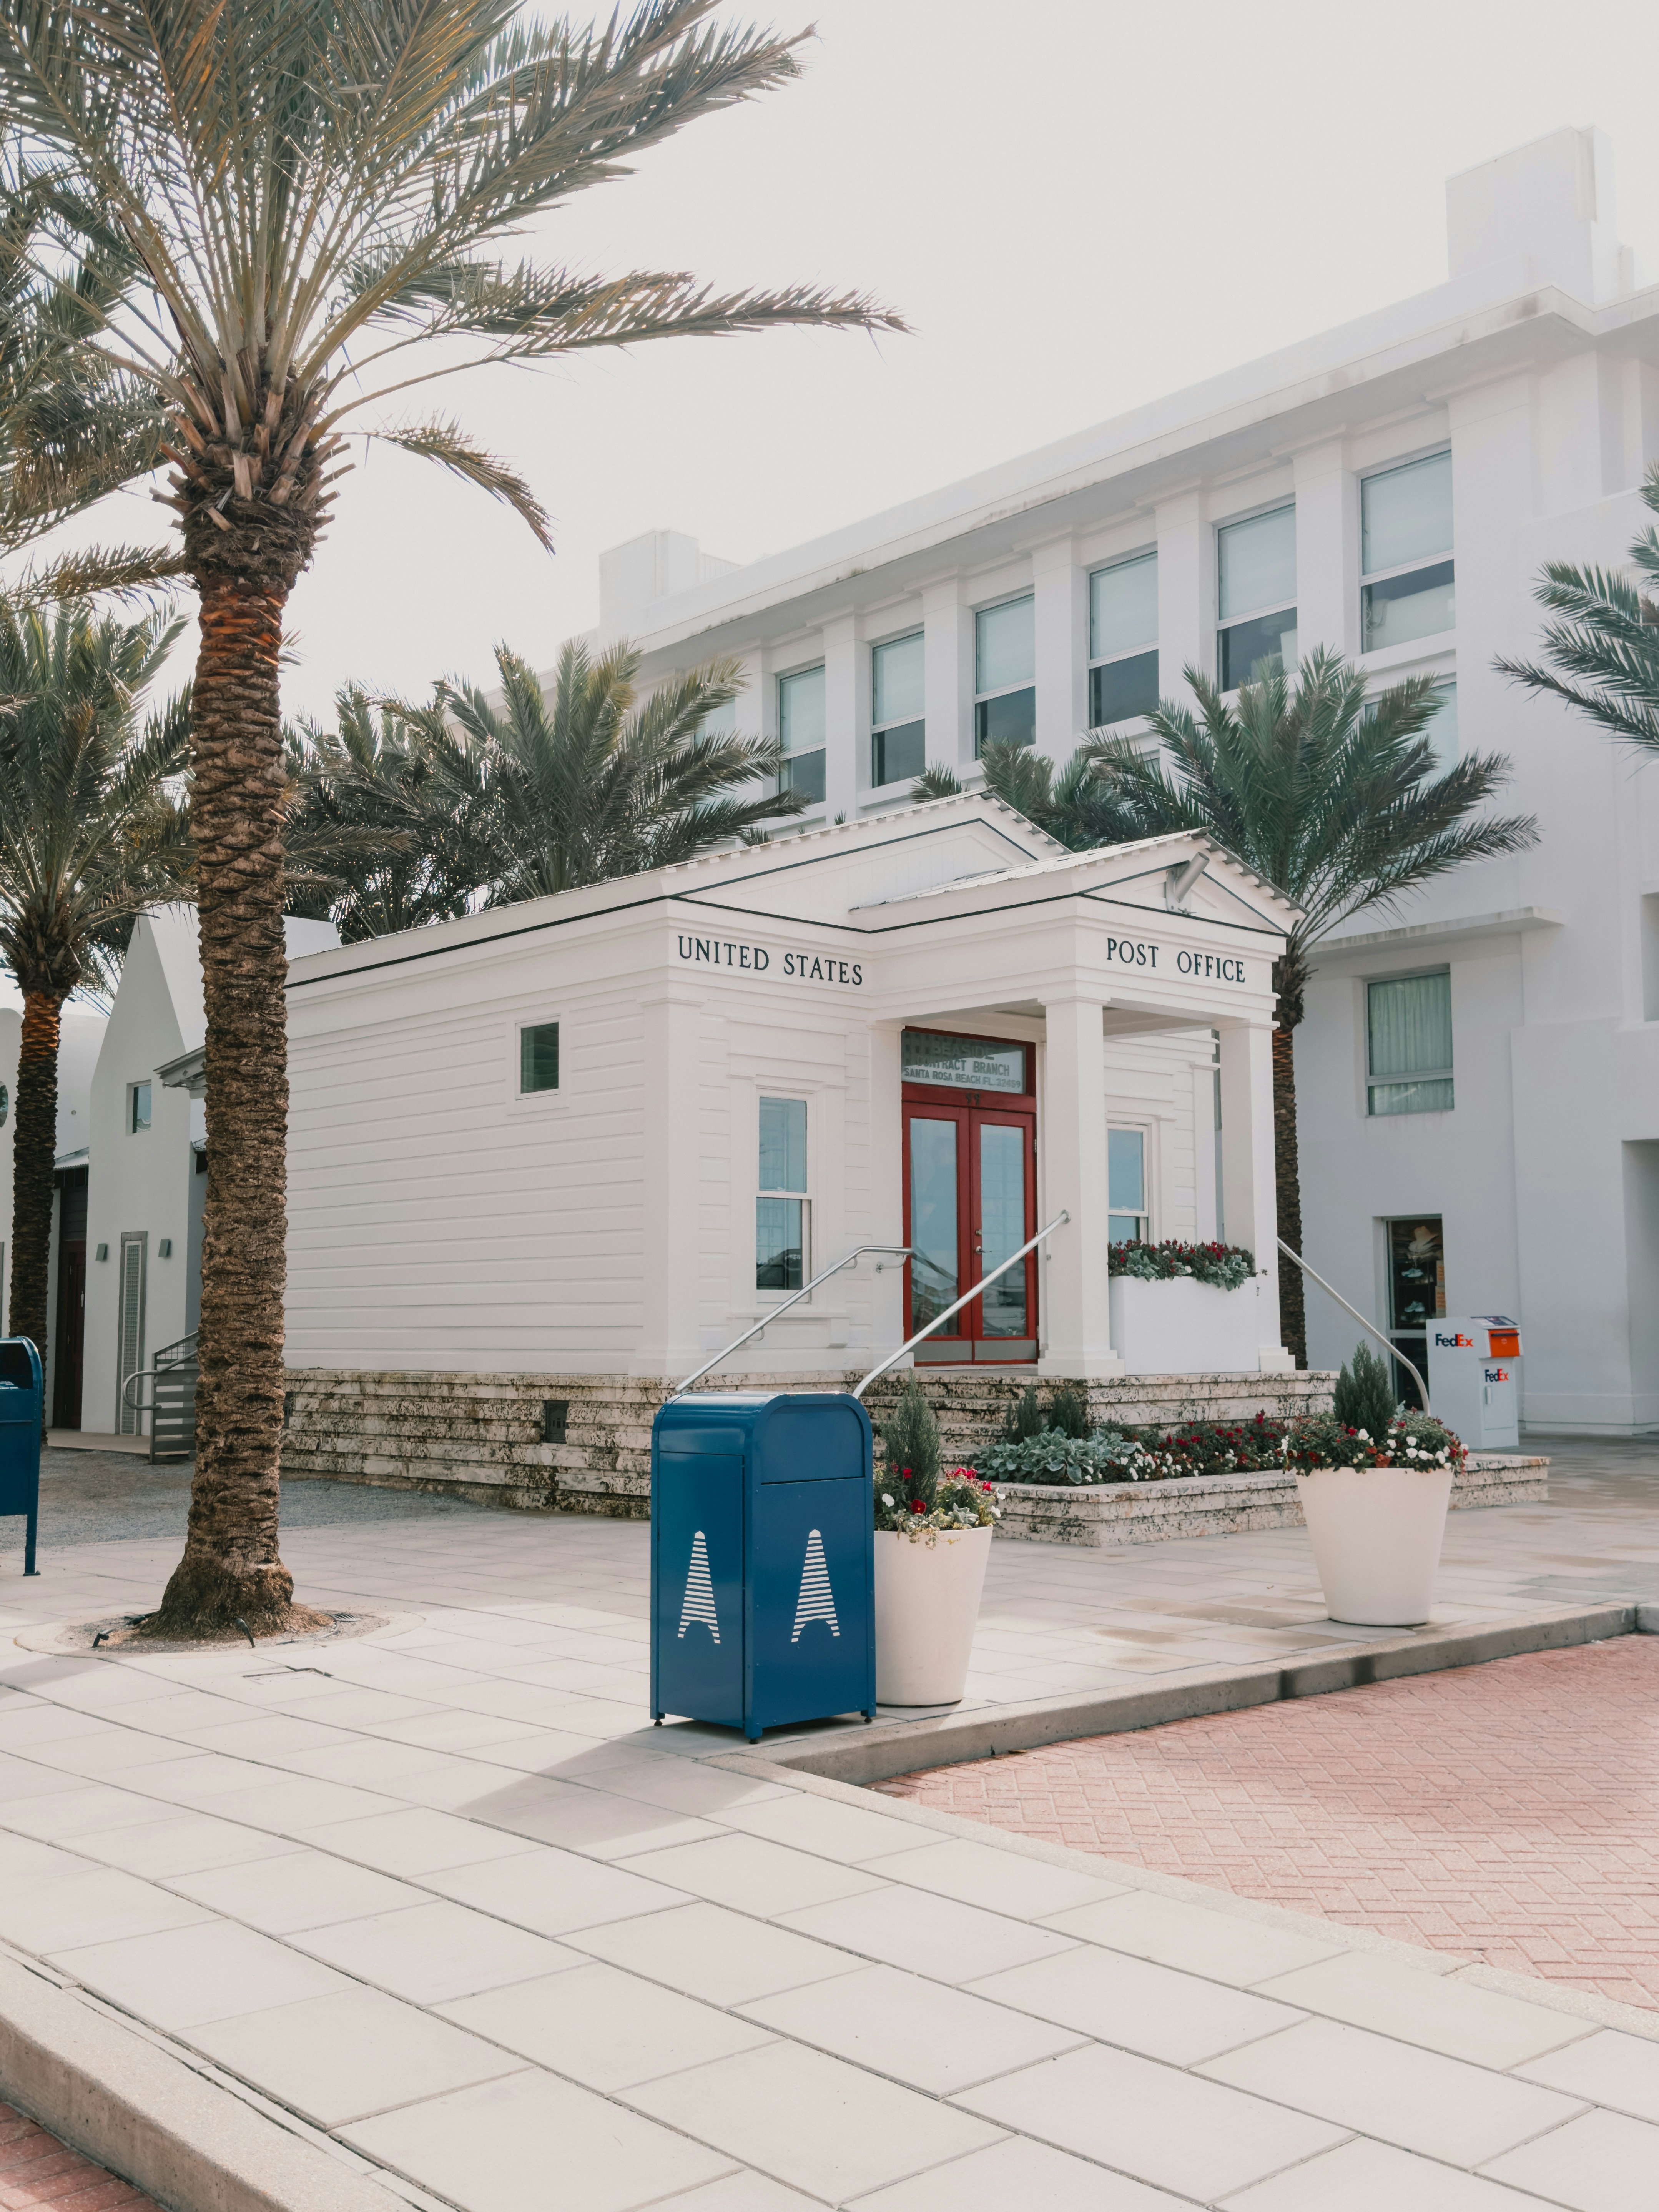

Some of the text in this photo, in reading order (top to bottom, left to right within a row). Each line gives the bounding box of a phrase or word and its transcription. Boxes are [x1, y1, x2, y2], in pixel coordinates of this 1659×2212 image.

[678, 935, 863, 985] UNITED STATES
[1107, 938, 1245, 983] POST OFFICE
[932, 1041, 995, 1060] SEASIDE
[917, 1055, 1010, 1076] CONTRACT BRANCH
[904, 1068, 930, 1079] SANTA
[932, 1071, 953, 1081] ROSA
[955, 1073, 981, 1084] BEACH
[996, 1078, 1021, 1088] 32459
[1435, 1333, 1473, 1347] FedEx
[1484, 1368, 1509, 1382] FedEx
